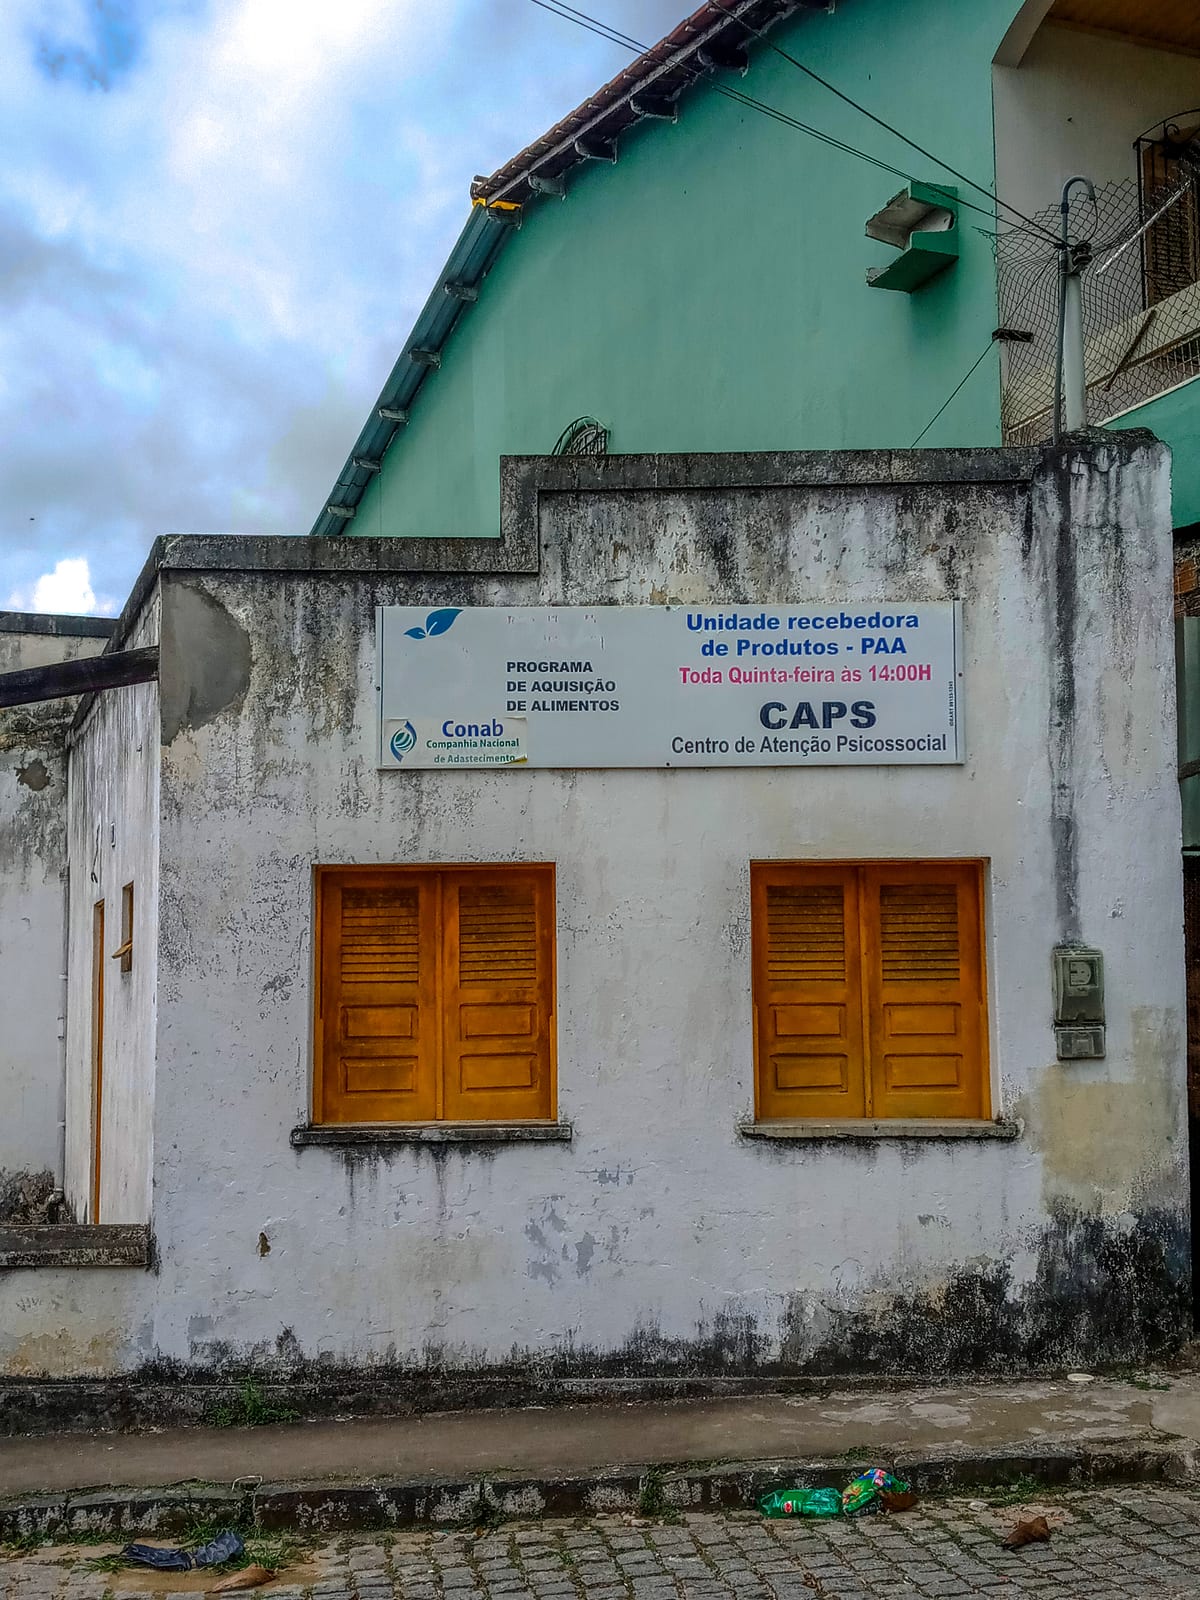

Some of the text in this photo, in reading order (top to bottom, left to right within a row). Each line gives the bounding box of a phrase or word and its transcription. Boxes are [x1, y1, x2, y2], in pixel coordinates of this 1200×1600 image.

[686, 611, 919, 631] Unidade recebedora
[701, 640, 729, 656] de
[737, 638, 839, 656] Produtos
[861, 637, 907, 654] PAA
[507, 661, 593, 673] PROGRAMA
[679, 664, 931, 684] Toda Quinta-feira às 14:00H
[507, 678, 616, 694] DE AQUISIÇÃO
[507, 700, 620, 712] DE ALIMENTOS
[759, 701, 877, 730] CAPS
[442, 719, 504, 738] Conab
[426, 738, 520, 750] Companhia Nacional
[671, 734, 947, 756] Centro de Atenção Psicossocial
[434, 754, 446, 764] de
